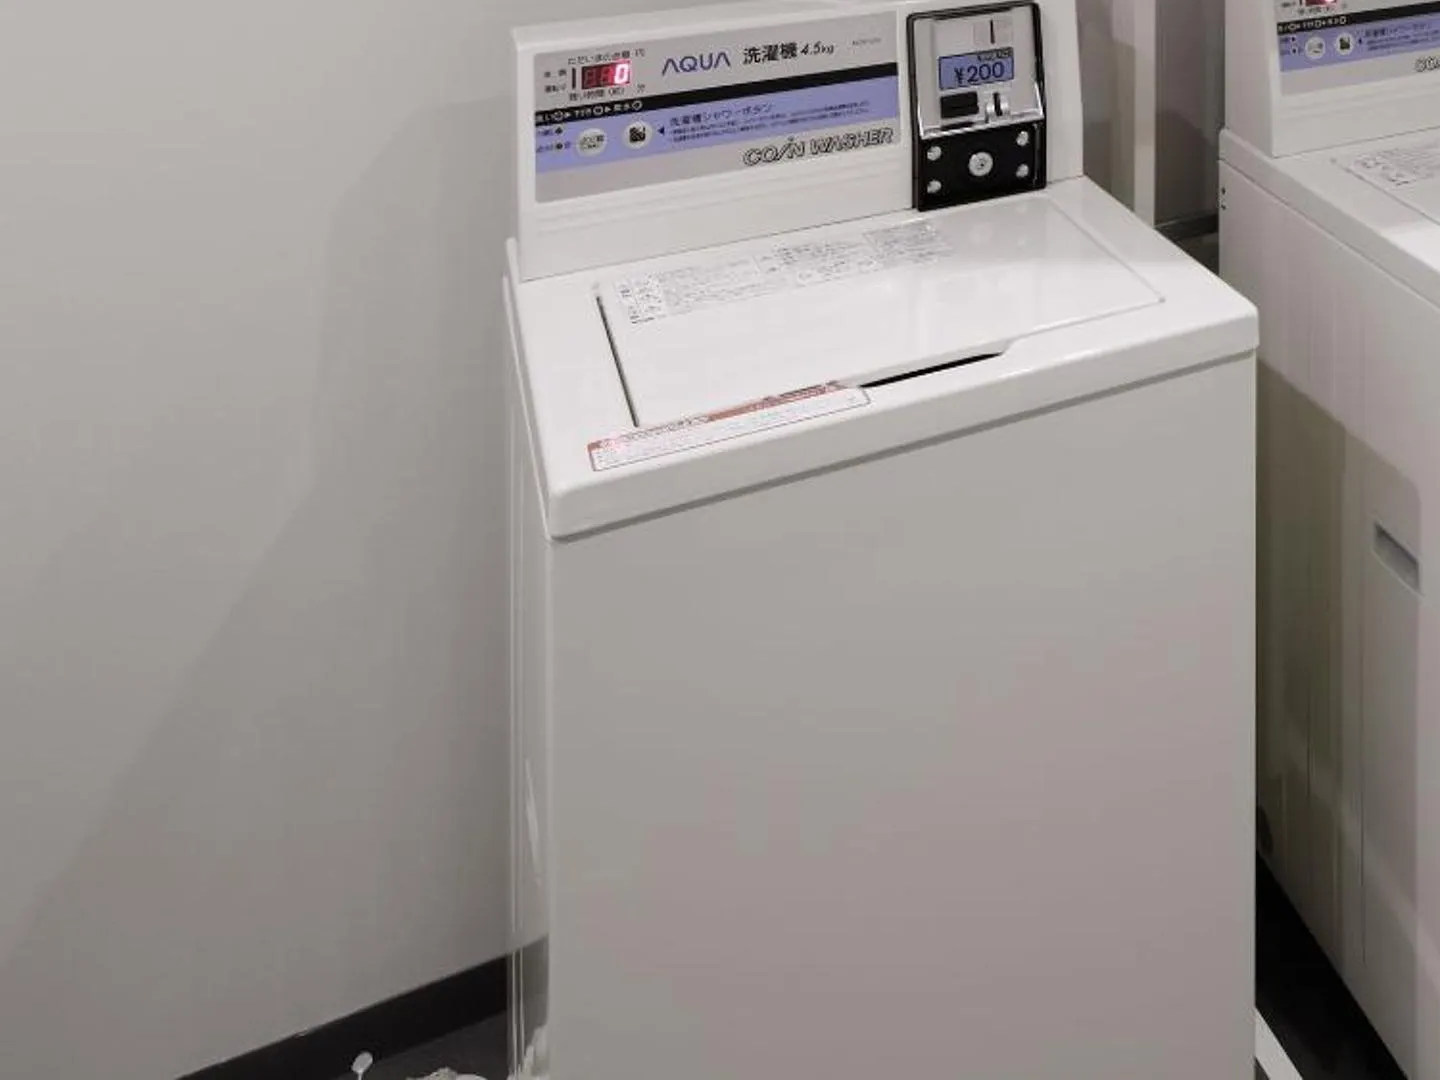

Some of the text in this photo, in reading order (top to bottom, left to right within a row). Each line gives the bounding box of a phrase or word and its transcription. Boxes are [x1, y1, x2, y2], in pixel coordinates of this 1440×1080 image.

[661, 50, 731, 76] AQUA
[743, 41, 798, 65] 洗濯機
[800, 40, 835, 57] 4.5kg
[614, 62, 630, 85] 0
[954, 61, 1006, 85] ¥200
[809, 126, 894, 156] WASHER
